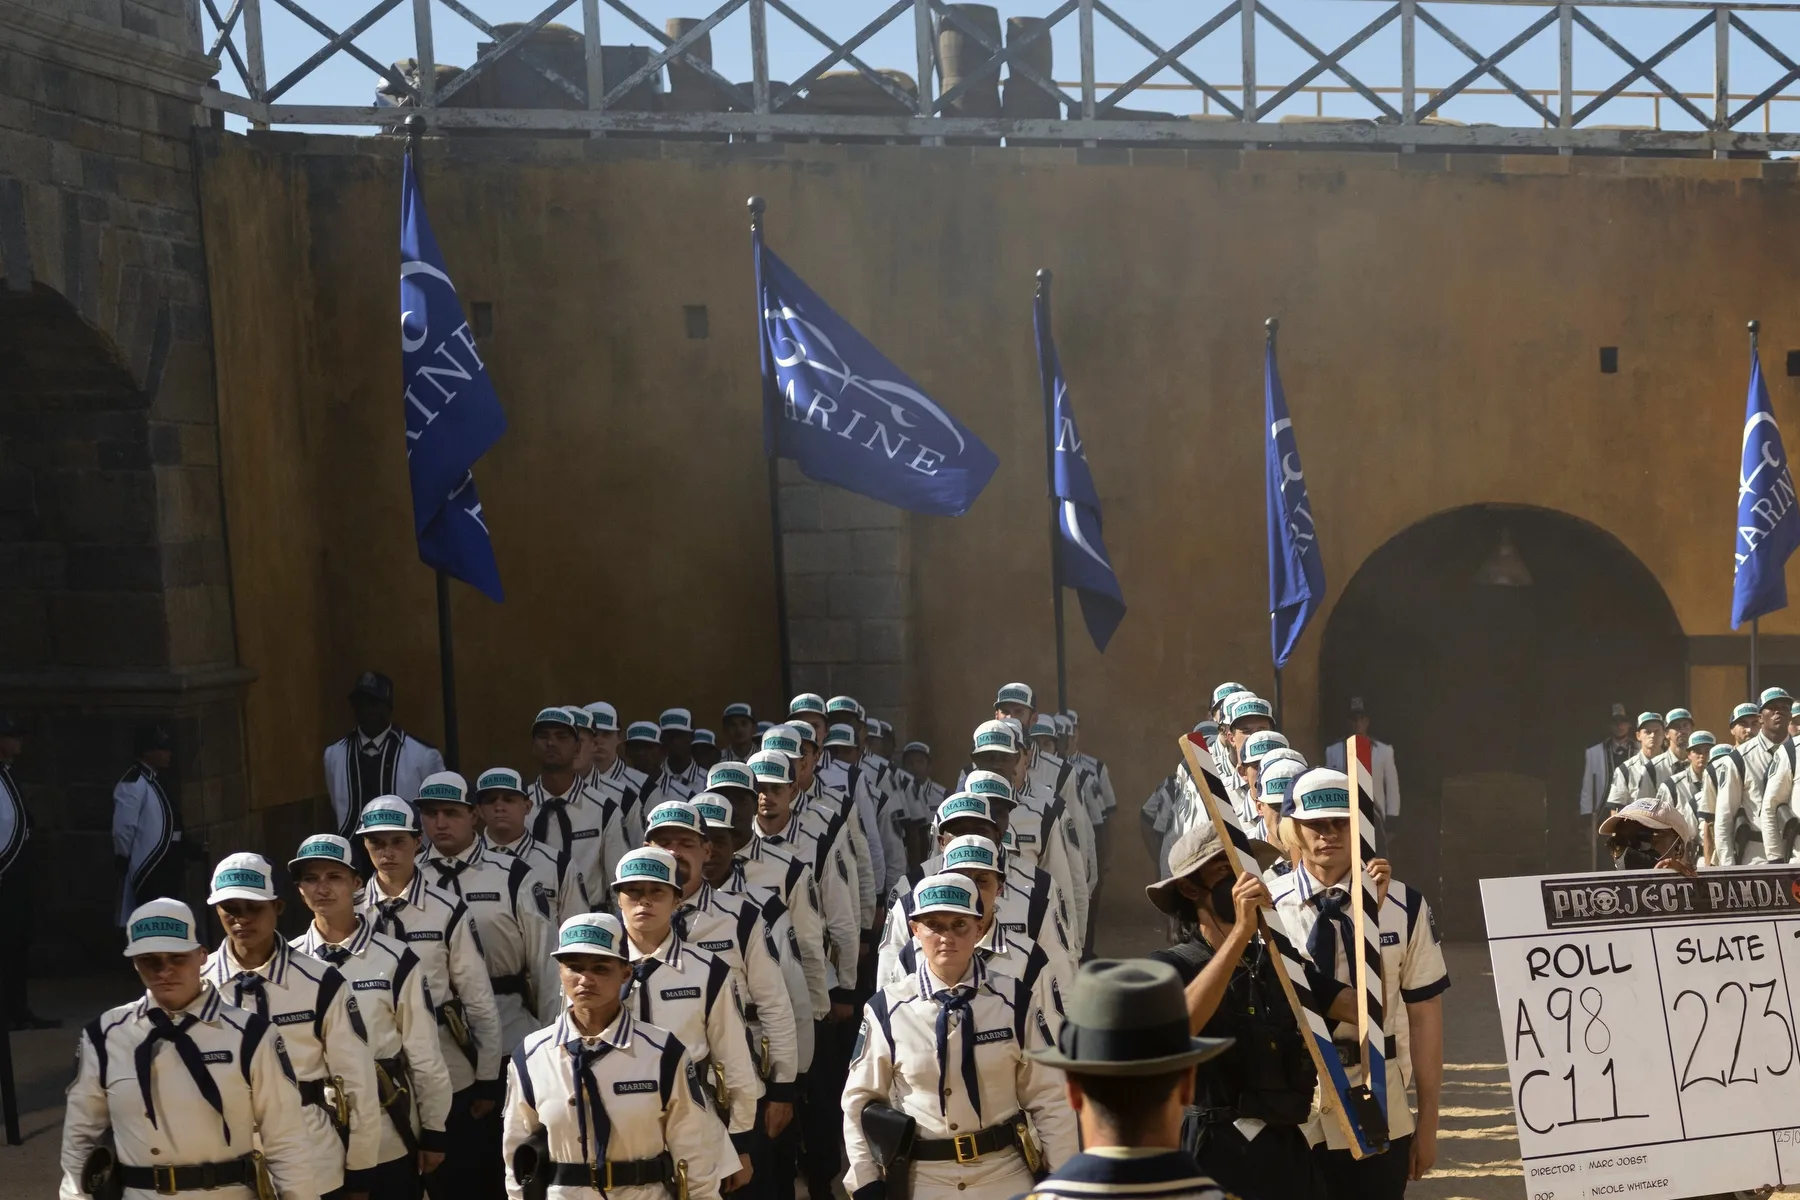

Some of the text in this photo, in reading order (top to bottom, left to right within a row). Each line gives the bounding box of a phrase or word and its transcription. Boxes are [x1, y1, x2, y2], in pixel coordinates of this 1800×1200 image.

[404, 321, 484, 459] INE
[777, 375, 945, 476] ARINE
[1734, 464, 1795, 578] ARIN
[979, 734, 1008, 742] MARINE
[766, 740, 796, 748] MARINE
[751, 764, 782, 774] MARINE
[482, 776, 514, 785] MARINE
[714, 772, 748, 782] MARINE
[423, 786, 456, 796] MARINE
[946, 800, 982, 810] MARINE
[654, 812, 690, 821] MARINE
[700, 807, 724, 816] RINE
[364, 812, 401, 824] MARINE
[302, 844, 339, 854] MARINE
[950, 850, 988, 860] MARINE
[625, 863, 666, 874] MARINE
[219, 873, 260, 883] MARINE
[924, 889, 966, 901] MARINE
[1552, 879, 1789, 918] PROJECT PANDA
[135, 921, 182, 932] MARINE
[564, 929, 608, 940] MARINE
[1380, 936, 1394, 944] DET
[702, 942, 728, 950] MARINE
[1526, 942, 1632, 981] ROLL
[1675, 934, 1765, 965] SLATE
[357, 980, 387, 989] MARINE
[666, 990, 696, 998] MARINE
[278, 1012, 310, 1024] MARINE
[1515, 986, 1611, 1061] A98
[977, 1030, 1008, 1041] MARINE
[1673, 978, 1794, 1092] 223
[202, 1052, 226, 1061] RINE
[619, 1082, 653, 1091] MARINE
[1518, 1058, 1650, 1134] C11
[1530, 1163, 1576, 1178] DIRECTOR
[1588, 1158, 1614, 1170] MARC
[1616, 1155, 1648, 1168] JOBST
[1591, 1183, 1625, 1197] NICOLE
[1625, 1178, 1669, 1193] WHITAKER
